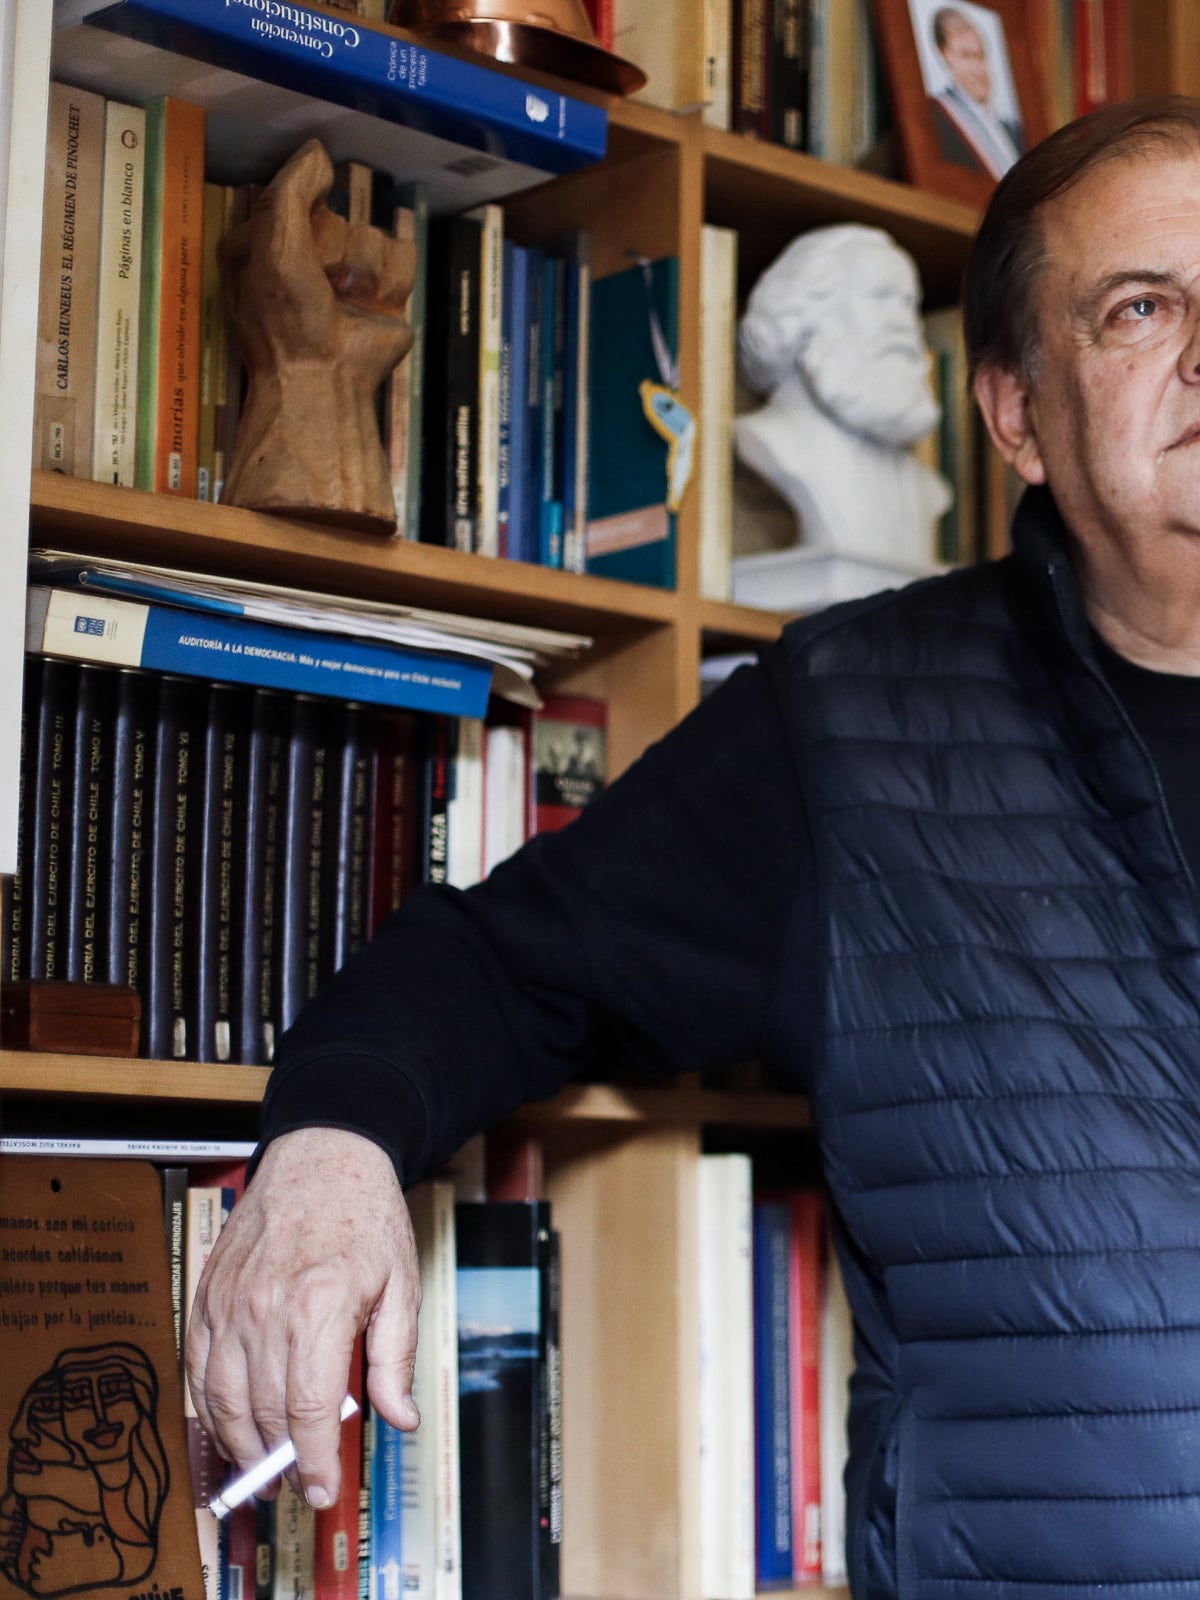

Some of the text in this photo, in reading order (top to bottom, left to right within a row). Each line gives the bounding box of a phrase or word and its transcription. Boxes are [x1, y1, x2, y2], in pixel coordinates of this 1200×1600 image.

[251, 18, 333, 58] Convención
[398, 49, 407, 79] de un
[408, 46, 417, 89] proceso
[121, 163, 134, 205] blanco
[123, 209, 132, 225] en
[57, 104, 80, 389] CARLOS HUNEEUS EL RÉGIMEN DE PINOCHET
[118, 229, 133, 279] Páginas
[170, 388, 184, 451] morias
[178, 635, 223, 651] AUDITORÍA
[224, 643, 230, 653] A
[232, 644, 242, 654] LA
[343, 662, 383, 677] democracia
[135, 730, 145, 739] V
[133, 743, 144, 780] TOMO
[176, 748, 189, 785] TOMO
[222, 754, 234, 791] TOMO
[132, 788, 143, 827] CHILE
[176, 793, 187, 832] CHILE
[221, 798, 233, 837] CHILE
[46, 715, 64, 979] TORIA DEL EJERCITO DE CHILE TOMO III
[84, 719, 102, 981] TORIA DEL EJERCITO DE CHILE TOMO IV
[131, 831, 142, 848] DE
[175, 835, 186, 854] DE
[221, 840, 232, 858] DE
[129, 852, 141, 914] EJERCITO
[174, 856, 185, 918] EJERCITO
[220, 861, 231, 922] EJERCITO
[12, 906, 22, 931] DEL
[128, 918, 138, 943] DEL
[173, 922, 184, 947] DEL
[219, 925, 229, 951] DEL
[11, 936, 21, 981] STORIA
[172, 951, 183, 1010] HISTORIA
[219, 955, 229, 1014] HISTORIA
[0, 1216, 135, 1232] manos son mi caricia
[2, 1244, 123, 1263] acordes cotidianos
[0, 1278, 149, 1300] uiero porque tus manos
[0, 1308, 38, 1331] bajan
[45, 1312, 64, 1329] por
[70, 1307, 82, 1325] la
